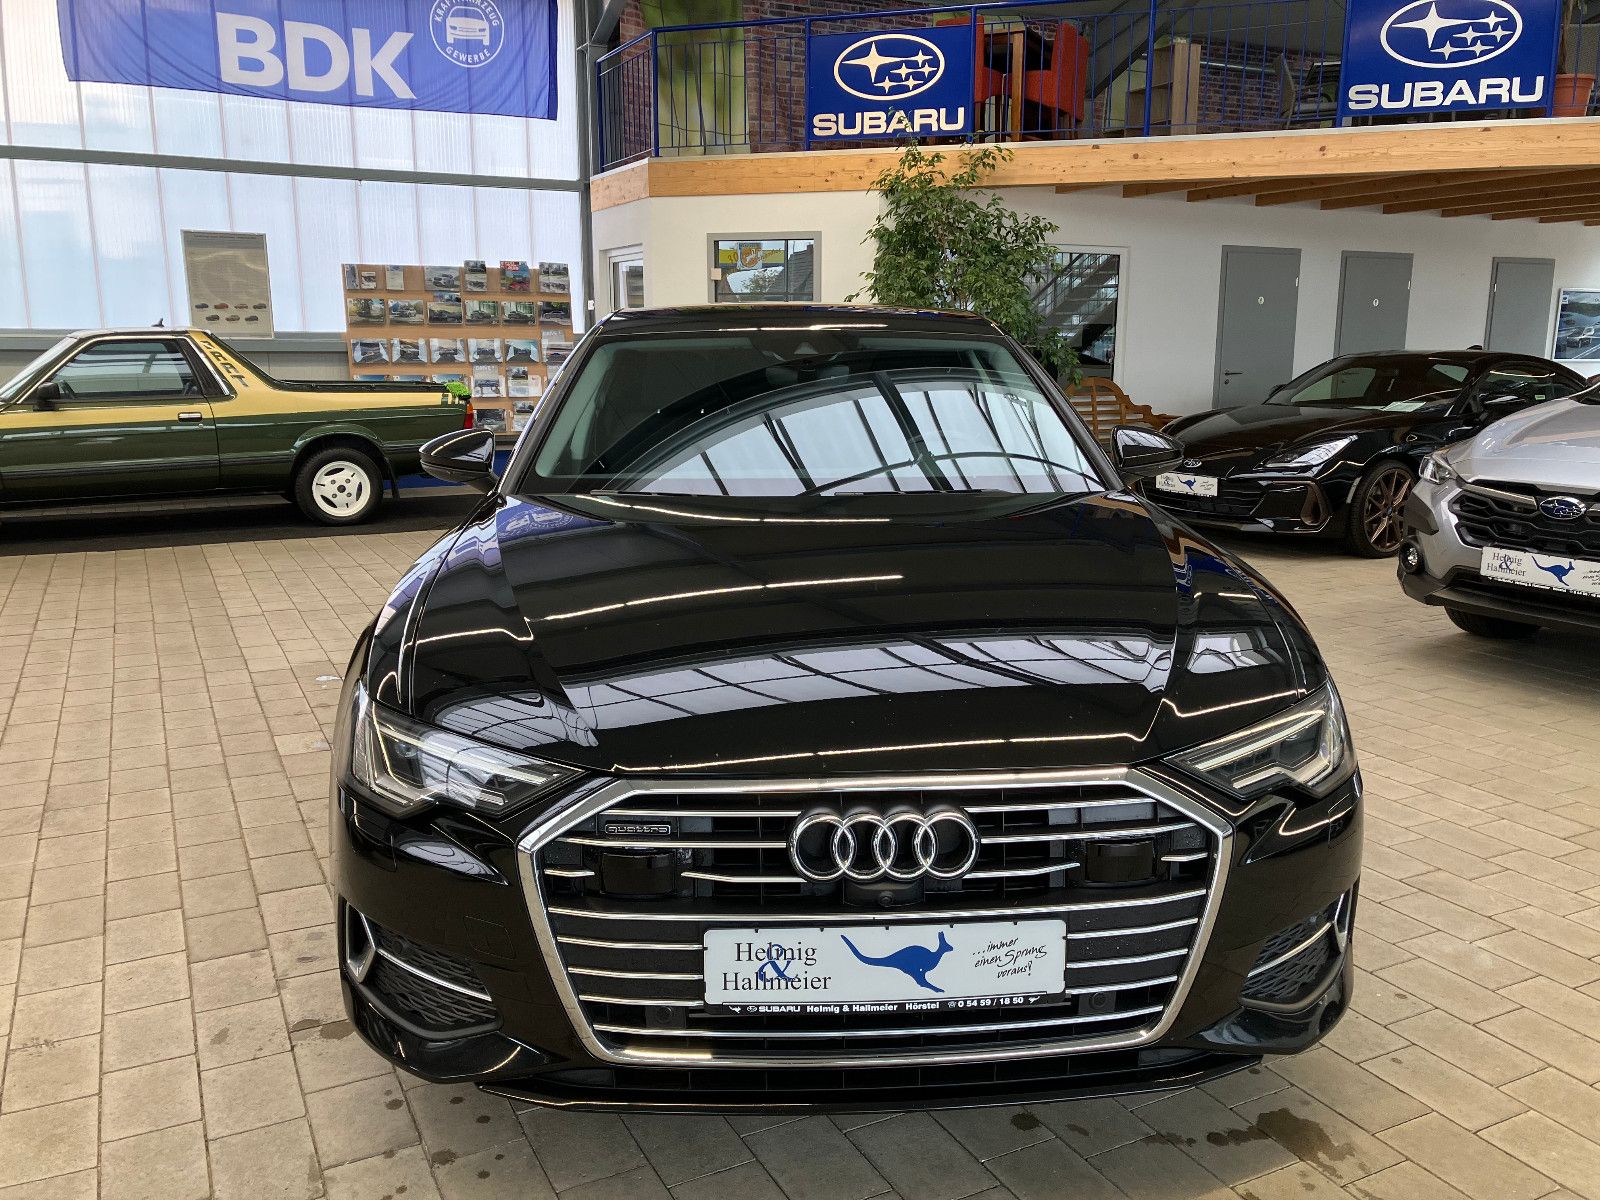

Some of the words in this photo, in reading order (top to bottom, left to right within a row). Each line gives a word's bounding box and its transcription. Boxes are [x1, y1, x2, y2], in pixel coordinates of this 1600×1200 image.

[216, 11, 417, 99] BDK
[445, 46, 491, 63] GEWERBE
[1348, 75, 1545, 110] SUBARU
[813, 107, 965, 136] SUBARU
[734, 941, 818, 966] Helmig
[758, 943, 796, 983] &
[975, 955, 1002, 968] einen
[997, 945, 1047, 968] Sprung
[722, 970, 832, 991] Hallmeier
[759, 1005, 801, 1013] SUBARU
[806, 1005, 840, 1014] Helmig
[842, 1004, 850, 1012] &
[852, 1003, 898, 1012] Hallmeier
[905, 1001, 940, 1010] Hörstel
[958, 1000, 964, 1008] 0
[966, 999, 978, 1007] 54
[980, 999, 991, 1007] 59
[1000, 997, 1010, 1005] 18
[1012, 996, 1024, 1004] 50
